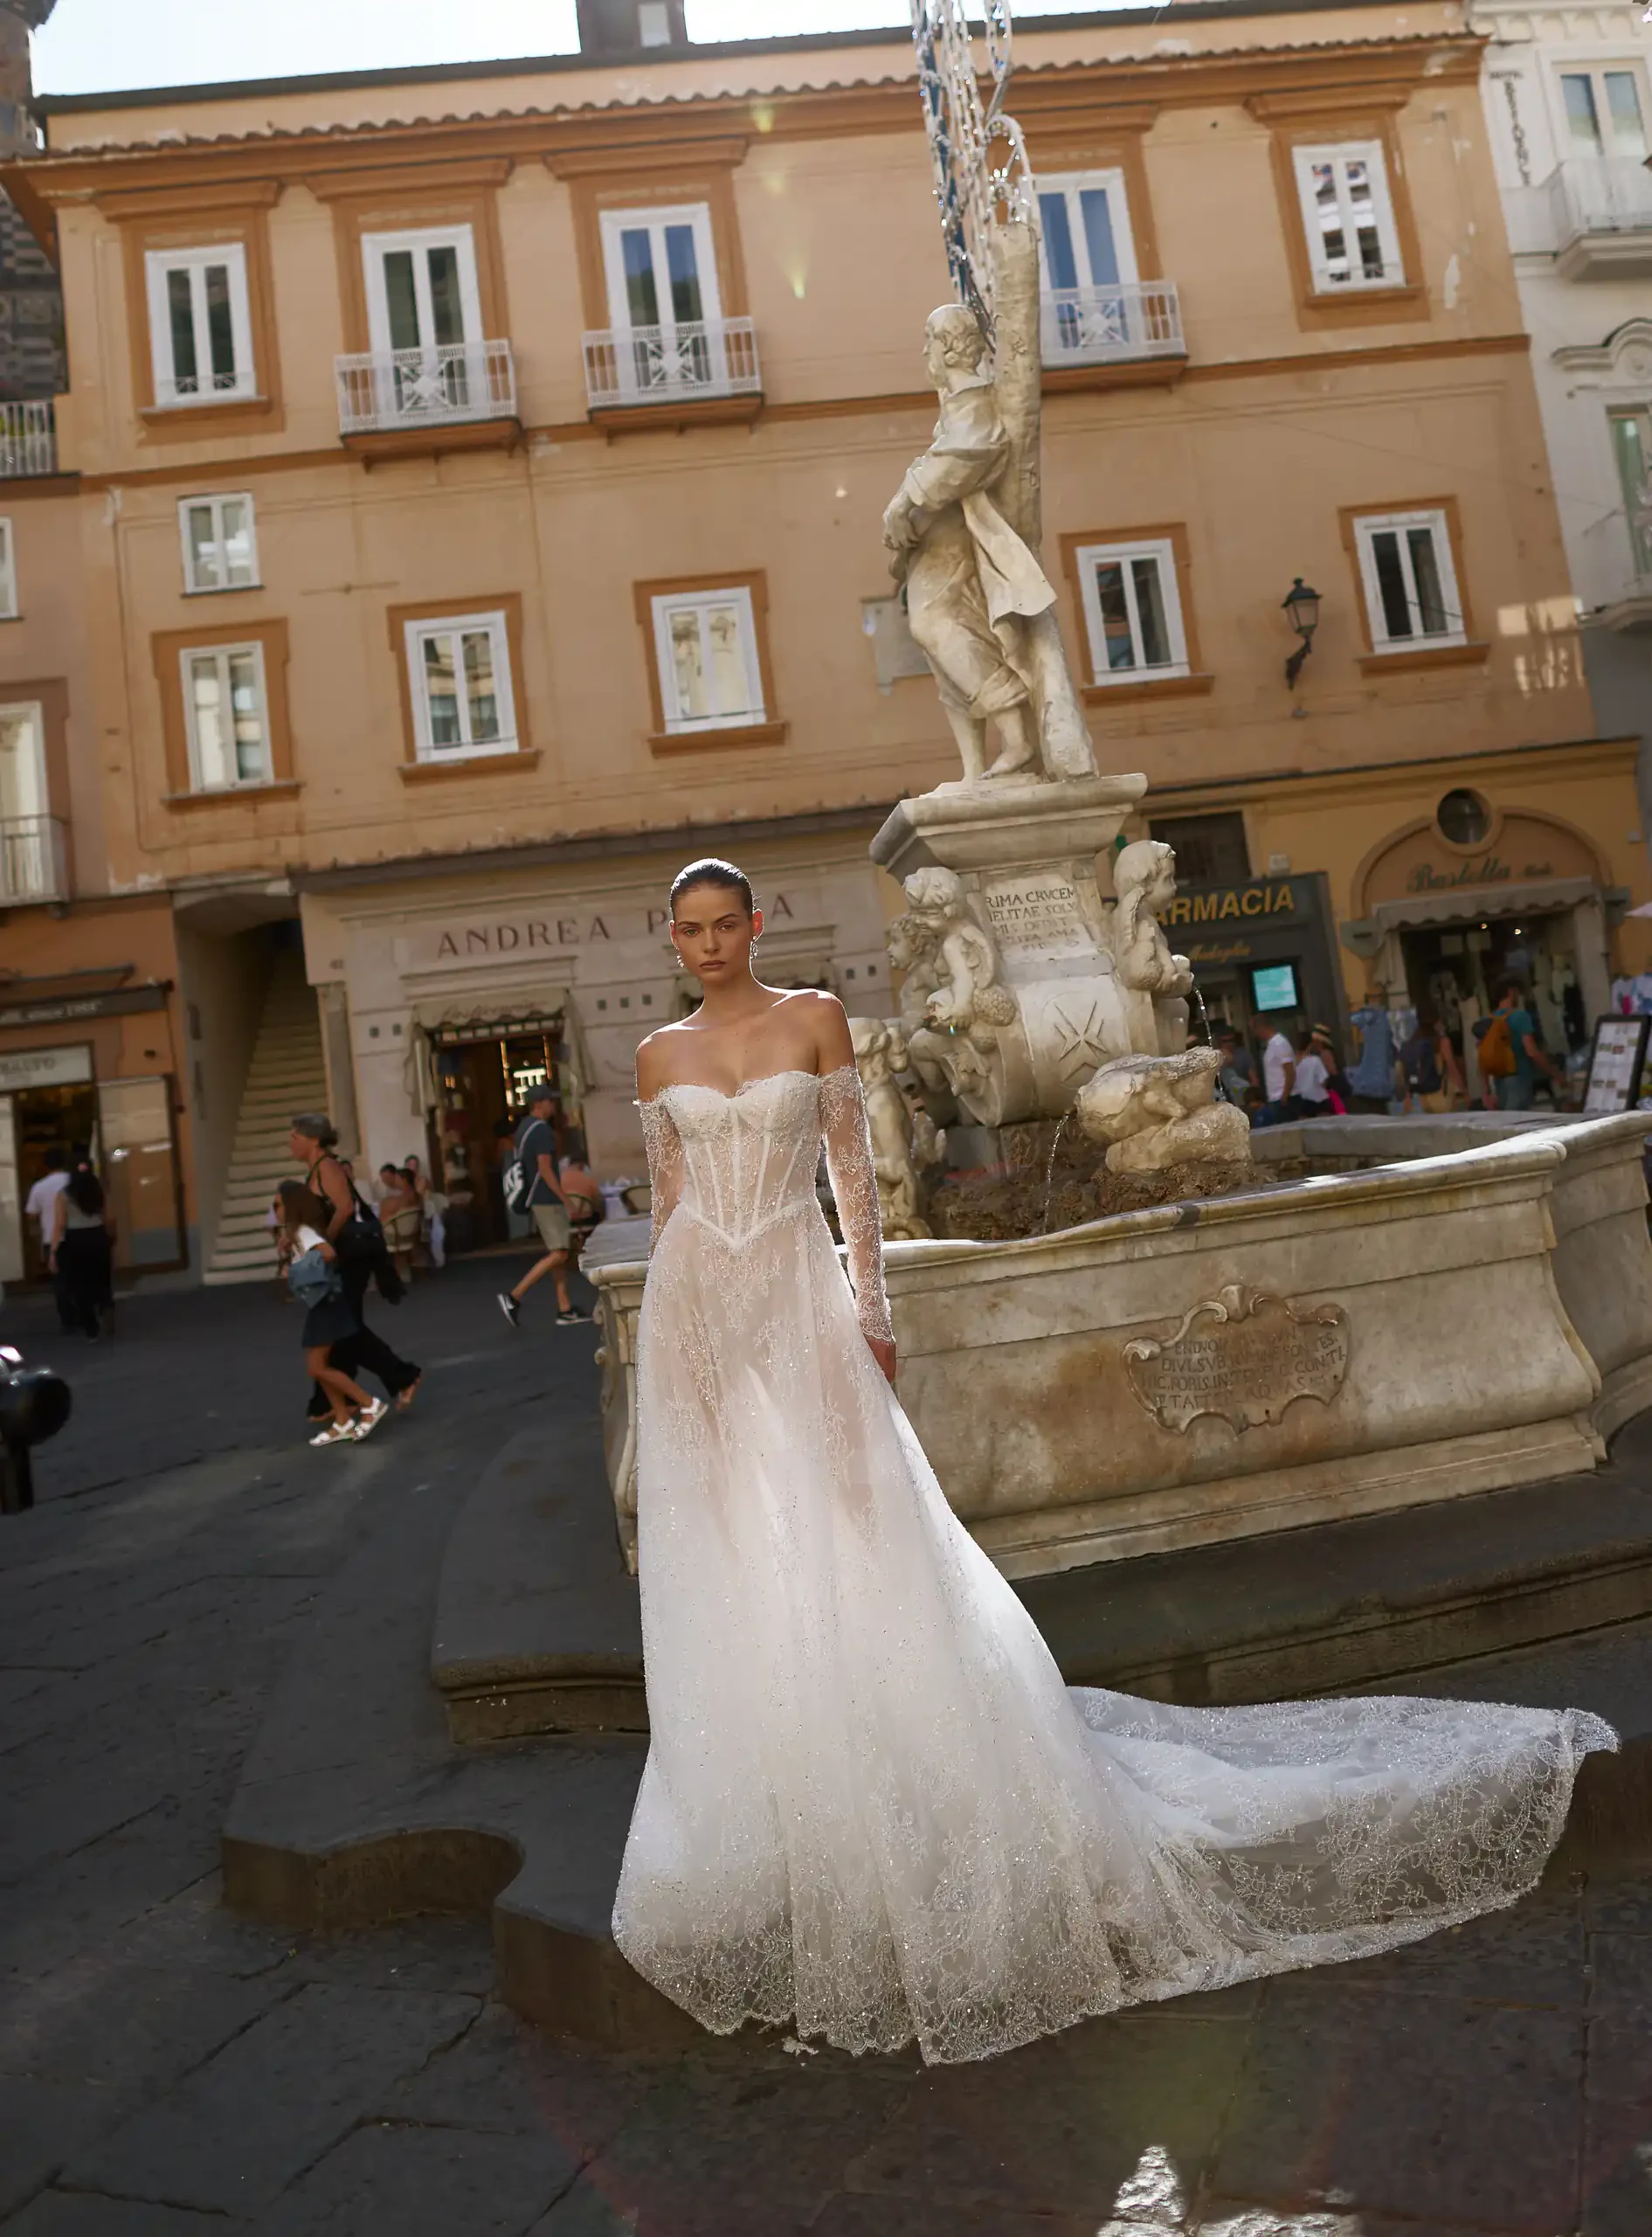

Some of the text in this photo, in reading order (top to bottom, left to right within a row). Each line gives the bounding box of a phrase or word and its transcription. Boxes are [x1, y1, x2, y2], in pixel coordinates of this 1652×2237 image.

[985, 893, 1024, 911] RIMA
[1154, 883, 1296, 925] ARMACIA
[438, 916, 611, 959] ANDREA
